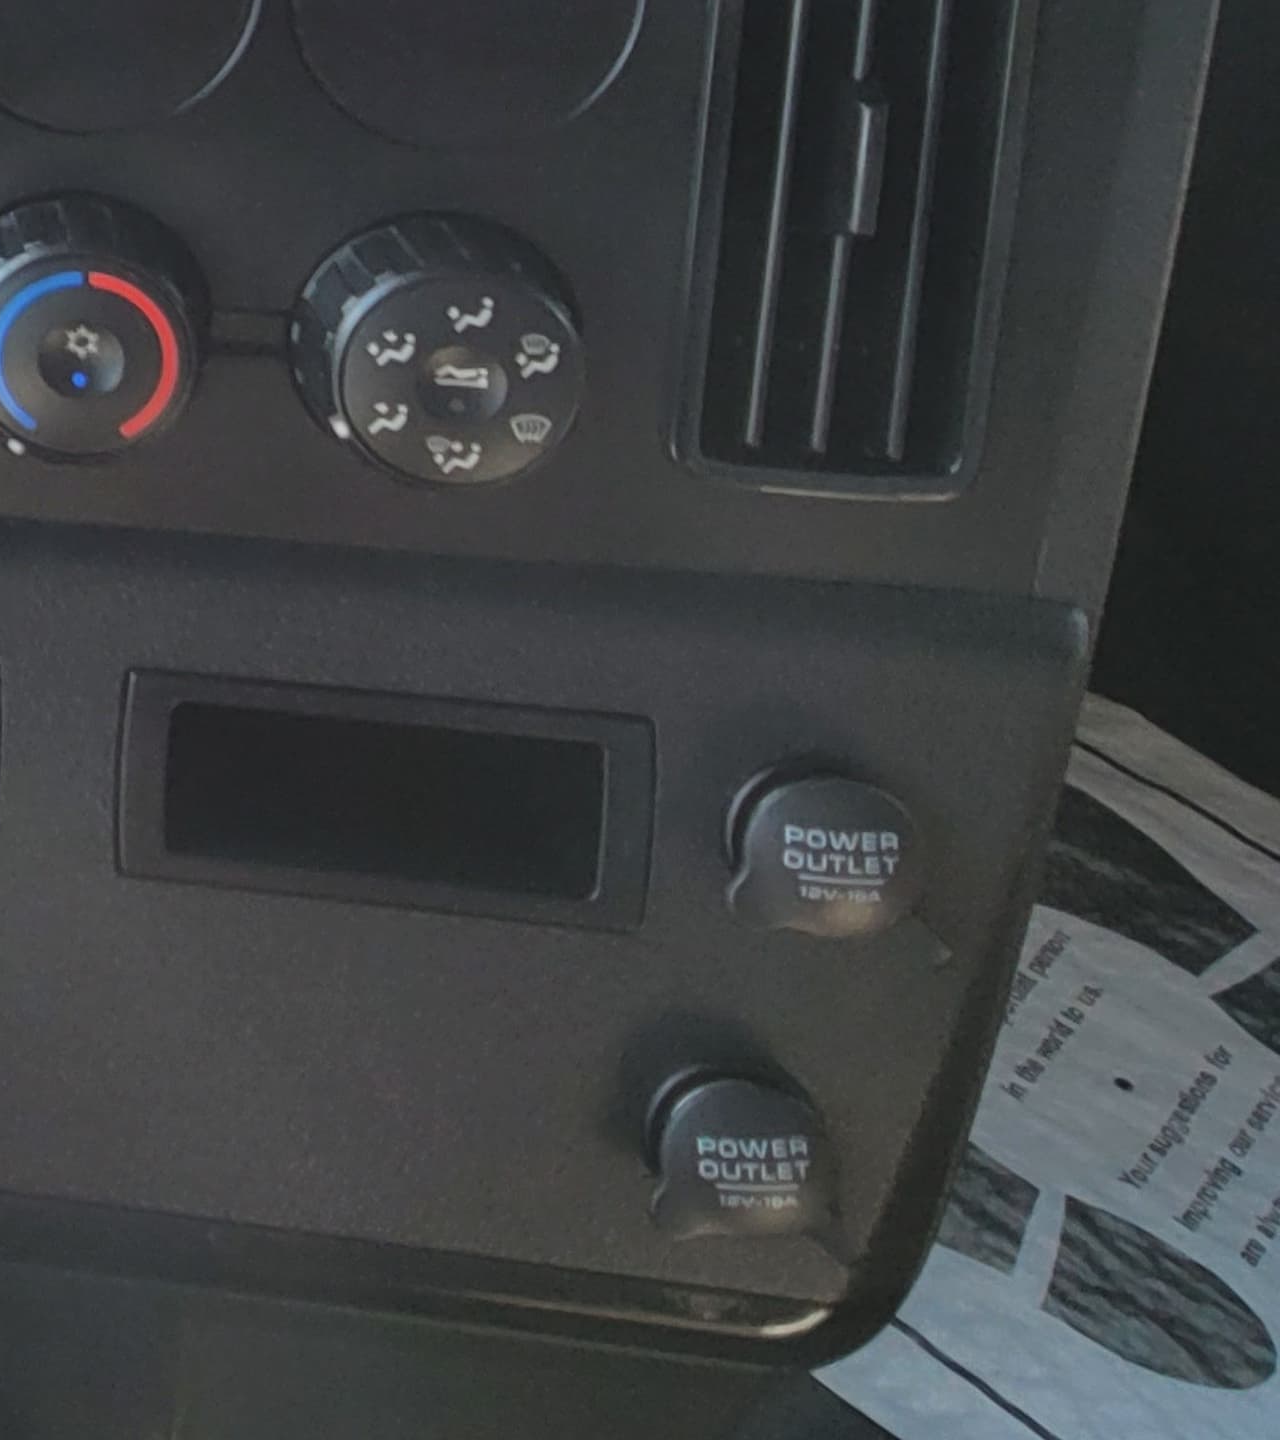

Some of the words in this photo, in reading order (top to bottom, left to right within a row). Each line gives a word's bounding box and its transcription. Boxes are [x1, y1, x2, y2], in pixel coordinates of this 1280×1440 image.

[783, 824, 900, 852] POWER
[782, 848, 900, 875] OUTLET
[1027, 929, 1072, 981] person
[1013, 1057, 1046, 1085] the
[1035, 1017, 1076, 1062] world
[1059, 1005, 1087, 1025] to
[1116, 1150, 1160, 1191] Your
[1147, 1070, 1219, 1158] suggestions
[1203, 1044, 1234, 1072] for
[695, 1135, 809, 1159] POWER
[1227, 1126, 1257, 1159] our
[697, 1158, 811, 1182] OUTLET
[1240, 1237, 1268, 1268] are
